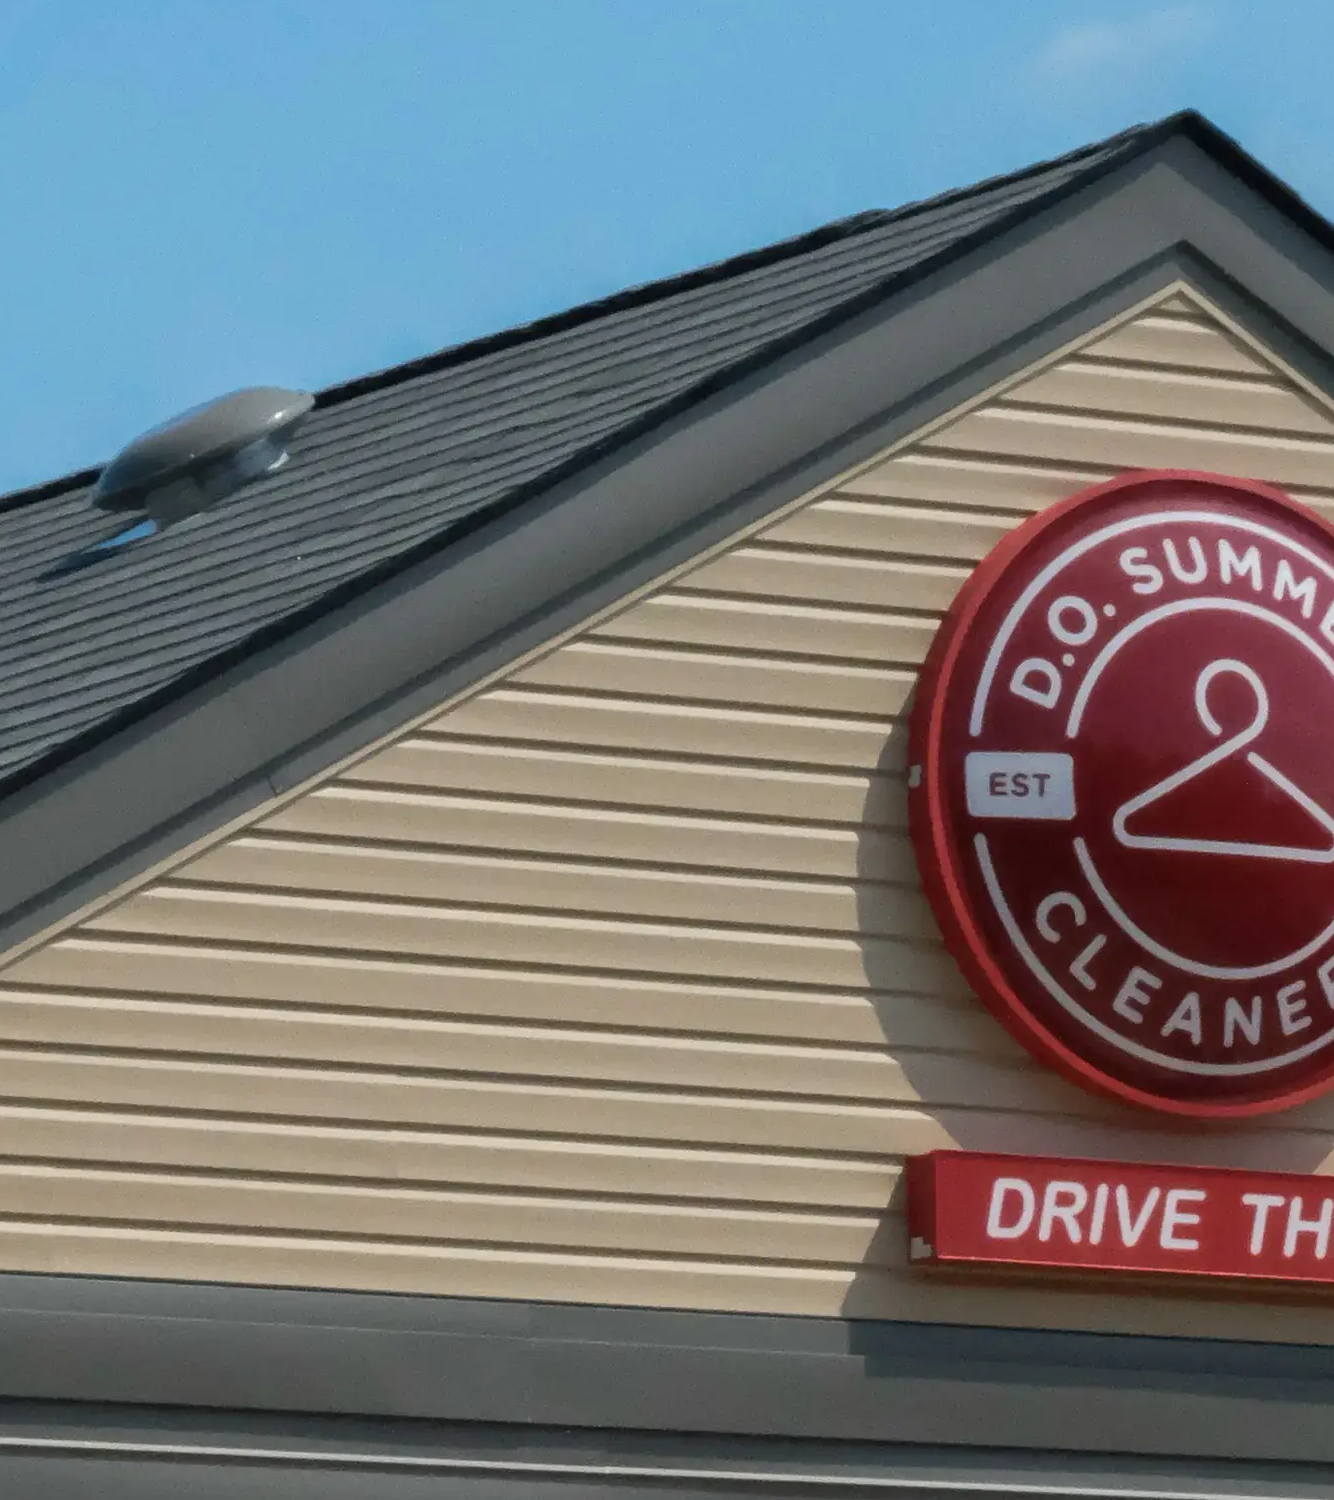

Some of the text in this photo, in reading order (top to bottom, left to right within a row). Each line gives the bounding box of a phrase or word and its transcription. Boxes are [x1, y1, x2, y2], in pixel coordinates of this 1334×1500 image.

[1010, 593, 1117, 710] D.O.
[989, 771, 1051, 798] EST
[985, 1177, 1207, 1251] DRIVE
